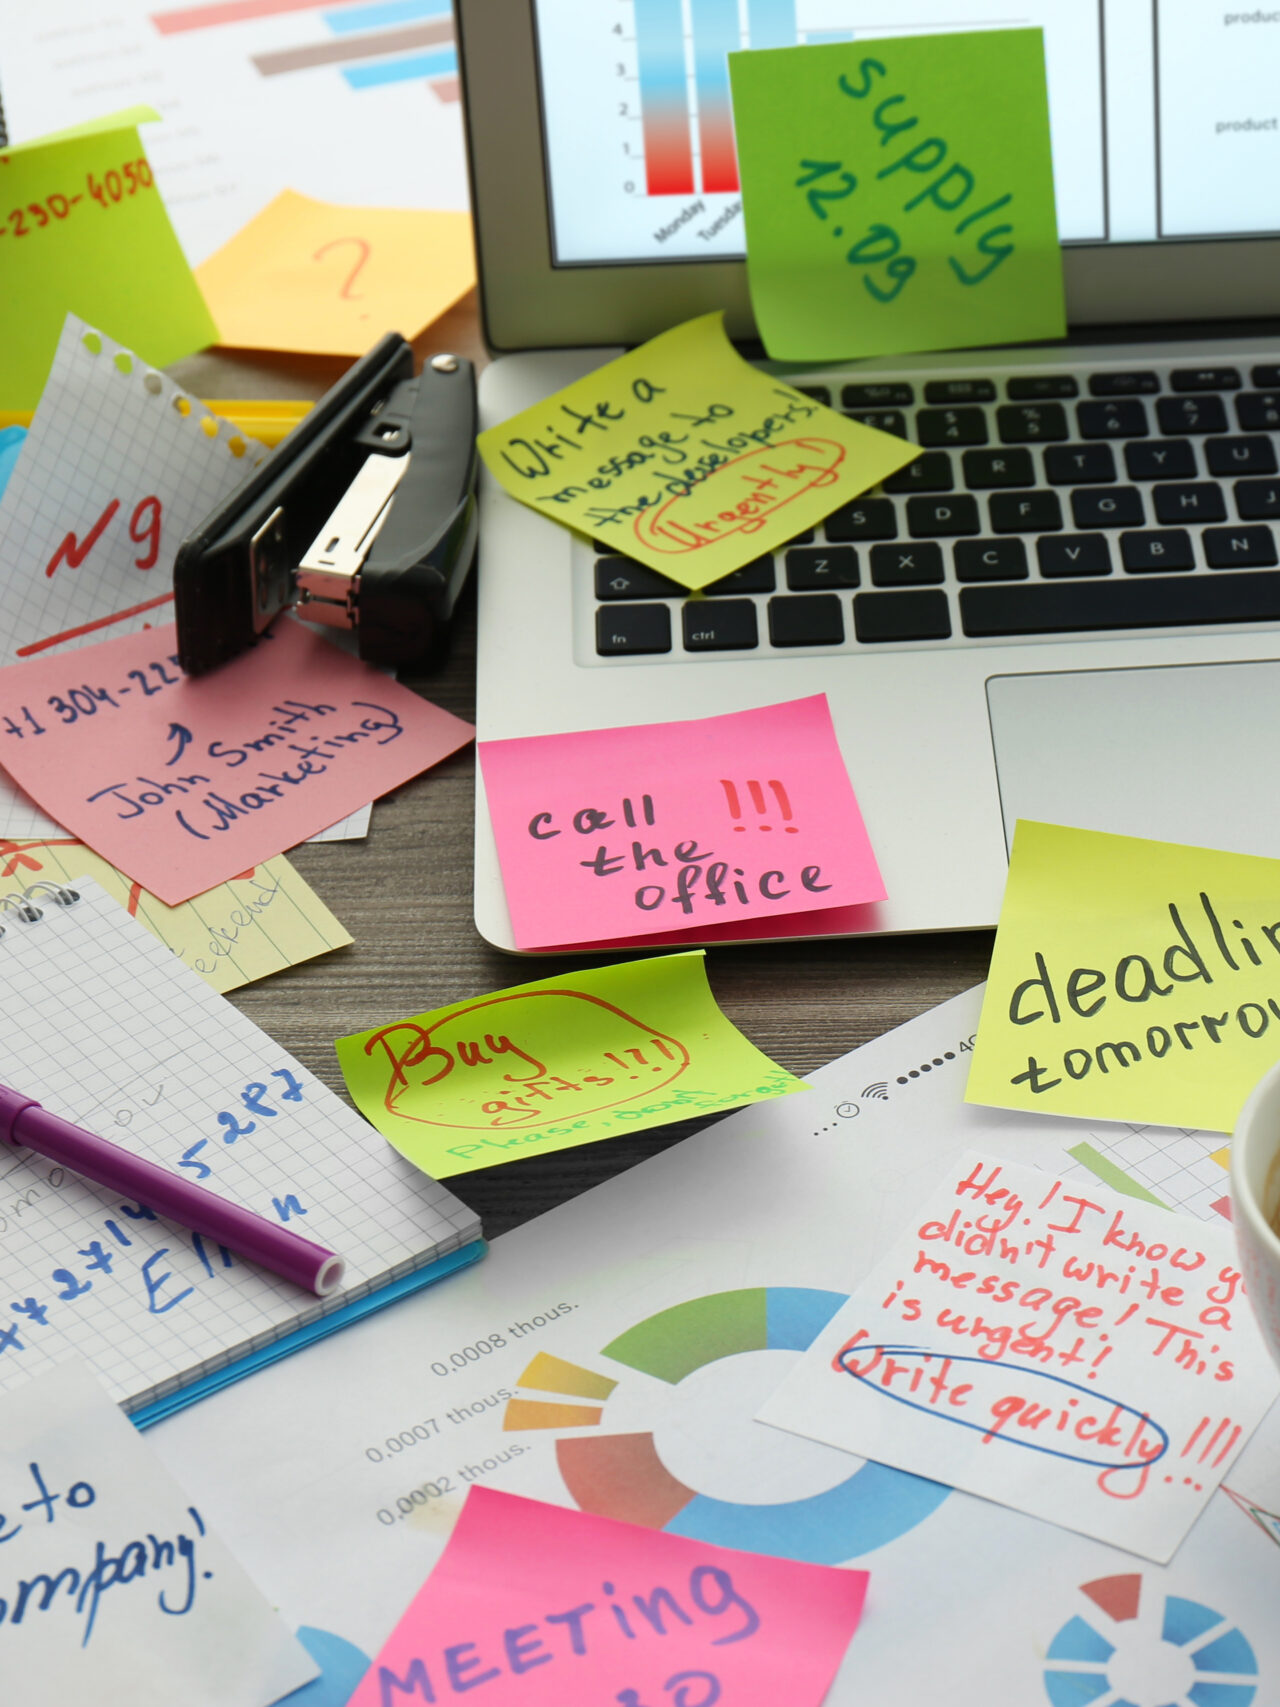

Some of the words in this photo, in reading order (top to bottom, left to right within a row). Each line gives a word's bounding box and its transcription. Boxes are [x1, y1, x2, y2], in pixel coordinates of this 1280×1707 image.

[1215, 117, 1279, 135] product
[835, 57, 1014, 286] supply
[653, 199, 706, 244] Monday
[696, 200, 743, 242] Tuesda
[313, 236, 372, 322] ?
[500, 402, 625, 480] Write
[632, 378, 666, 404] a
[536, 425, 689, 504] message
[671, 402, 733, 429] to
[910, 464, 922, 478] E
[992, 459, 1007, 474] R
[1074, 454, 1087, 469] T
[1153, 450, 1168, 465] Y
[1233, 447, 1250, 461] U
[852, 510, 867, 524] S
[935, 506, 951, 521] D
[1019, 502, 1032, 517] F
[1098, 498, 1117, 513] G
[1180, 494, 1198, 509] H
[1265, 490, 1277, 504] J
[814, 560, 830, 574] Z
[898, 554, 915, 569] X
[982, 550, 999, 566] C
[1064, 545, 1082, 560] V
[1149, 541, 1165, 556] B
[1231, 538, 1250, 553] N
[611, 633, 628, 645] fn
[691, 630, 716, 642] ctrl
[87, 774, 210, 819] John
[208, 700, 337, 767] Smith
[175, 701, 404, 839] (Marketing)
[528, 794, 656, 840] call
[719, 779, 799, 834] !!!
[580, 839, 714, 877] the
[634, 862, 833, 915] office
[364, 1021, 548, 1086] Buy
[955, 1162, 1062, 1235] Hey!
[1047, 1195, 1106, 1234] I
[1102, 1210, 1206, 1272] know
[917, 1208, 1056, 1268] didn't
[1062, 1256, 1185, 1306] write
[1199, 1306, 1232, 1331] a
[430, 1333, 508, 1377] 0.0008
[507, 1301, 580, 1339] thous.
[882, 1279, 922, 1321] is
[936, 1308, 1114, 1380] urgent!
[912, 1251, 1140, 1340] message!
[1145, 1317, 1235, 1382] This
[831, 1329, 974, 1406] Write
[364, 1417, 442, 1464] 0.0007
[446, 1387, 520, 1425] thous.
[22, 1462, 96, 1523] to
[376, 1475, 457, 1527] 0.0002
[457, 1442, 532, 1483] thous.
